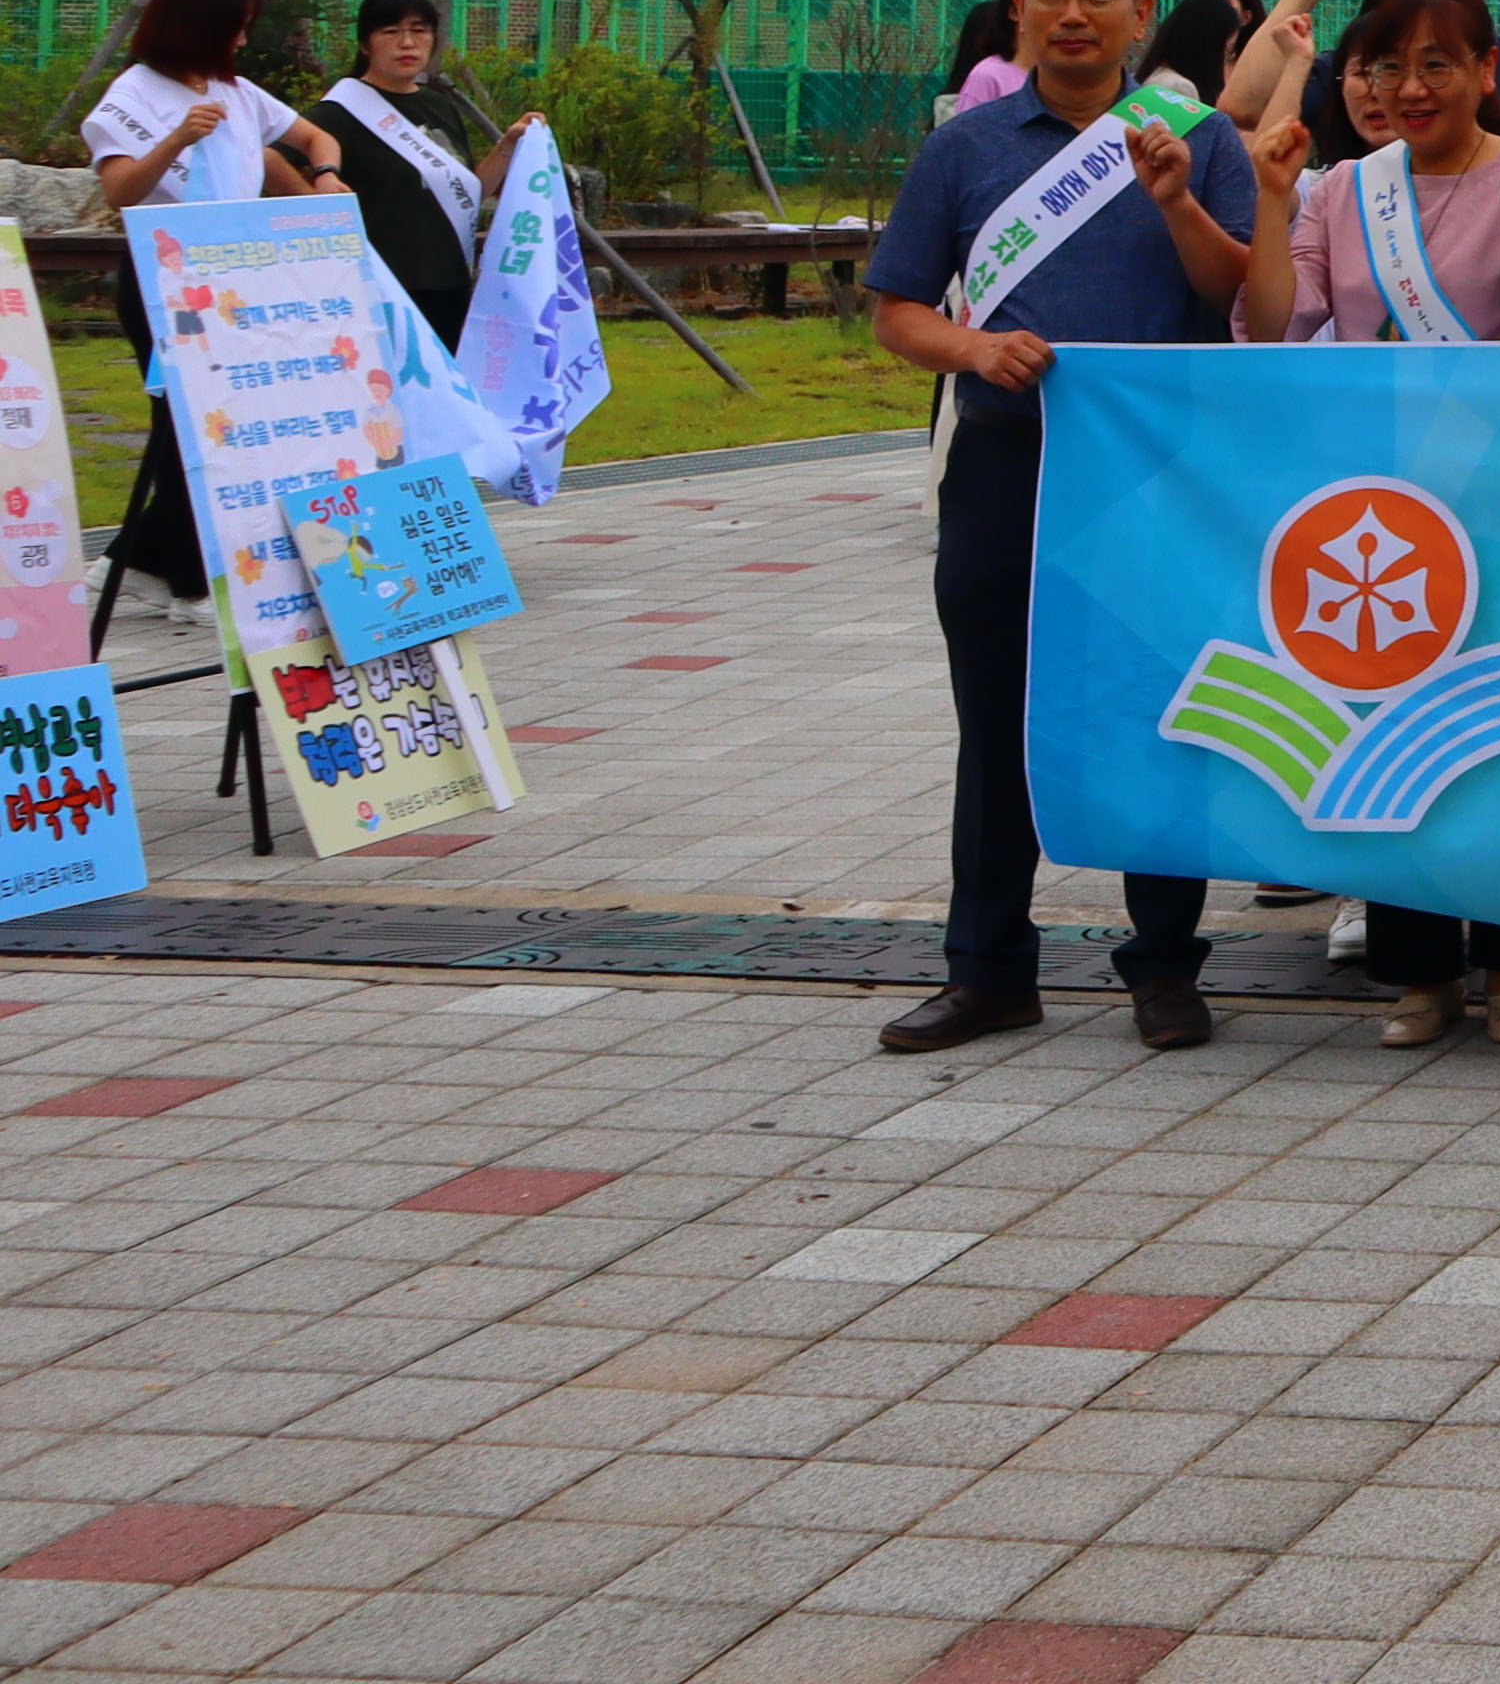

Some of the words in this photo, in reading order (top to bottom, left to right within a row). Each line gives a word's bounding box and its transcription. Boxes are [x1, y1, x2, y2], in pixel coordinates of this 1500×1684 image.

[1080, 140, 1126, 181] 스승
[988, 217, 1038, 266] 제자
[308, 485, 360, 524] STOP
[401, 510, 437, 539] 싫은
[436, 500, 470, 528] 일은
[421, 531, 474, 563] 친구도
[381, 693, 488, 758] 가슴속
[0, 858, 96, 900] 도사천교육지원청
